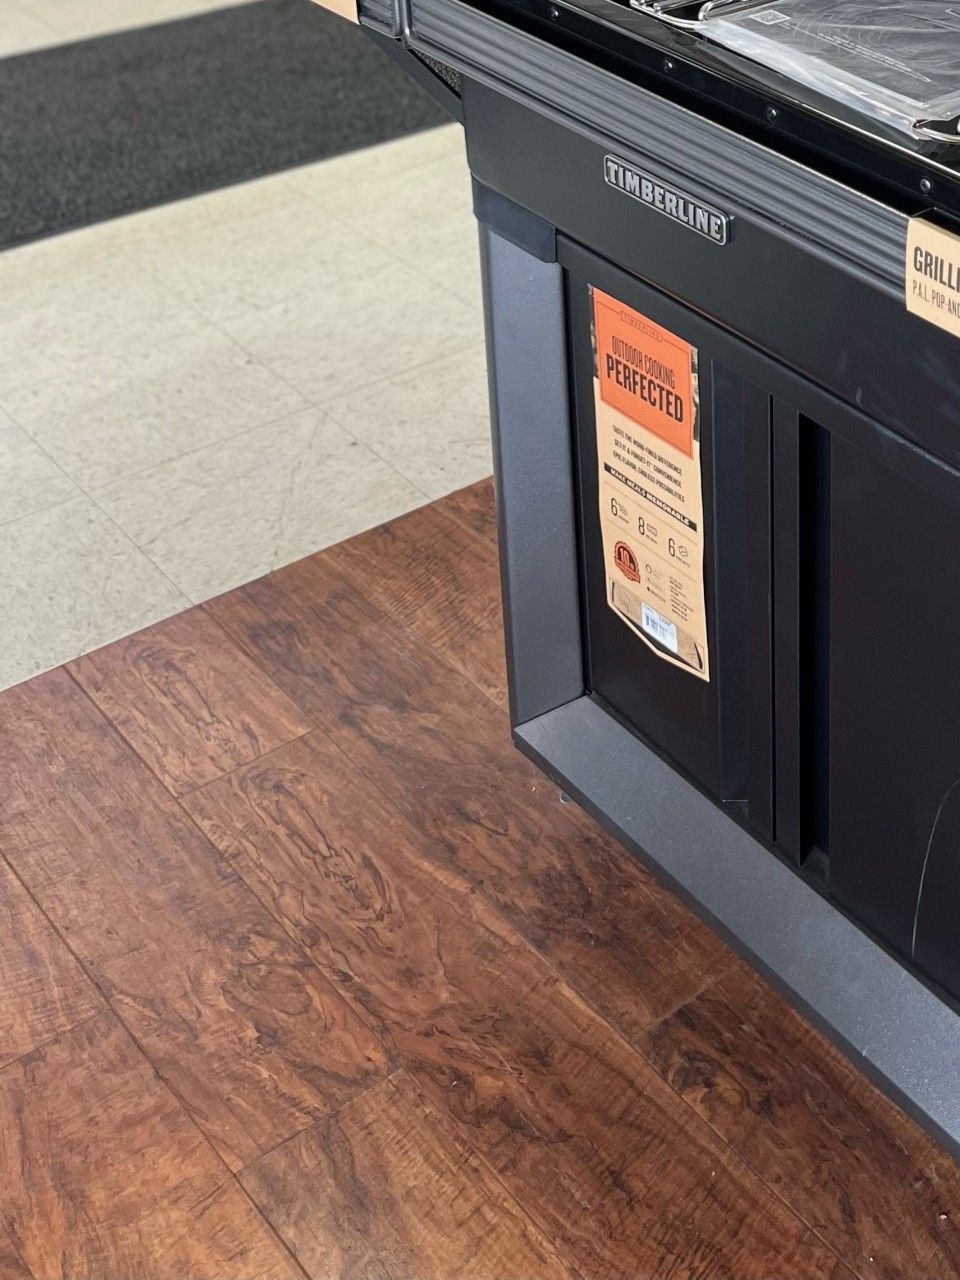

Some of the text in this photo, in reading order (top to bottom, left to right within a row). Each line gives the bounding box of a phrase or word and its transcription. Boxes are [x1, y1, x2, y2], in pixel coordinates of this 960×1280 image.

[607, 161, 722, 240] TIMBERLINE
[912, 279, 930, 304] P.A.L.
[612, 335, 675, 389] OUTDOOR COOKING
[606, 353, 683, 423] PERFECTED
[610, 467, 626, 483] MAKE
[626, 476, 647, 497] MEALS
[646, 489, 690, 526] MEMORABLE
[611, 497, 617, 516] 6
[638, 516, 645, 535] 8
[668, 538, 676, 558] 6
